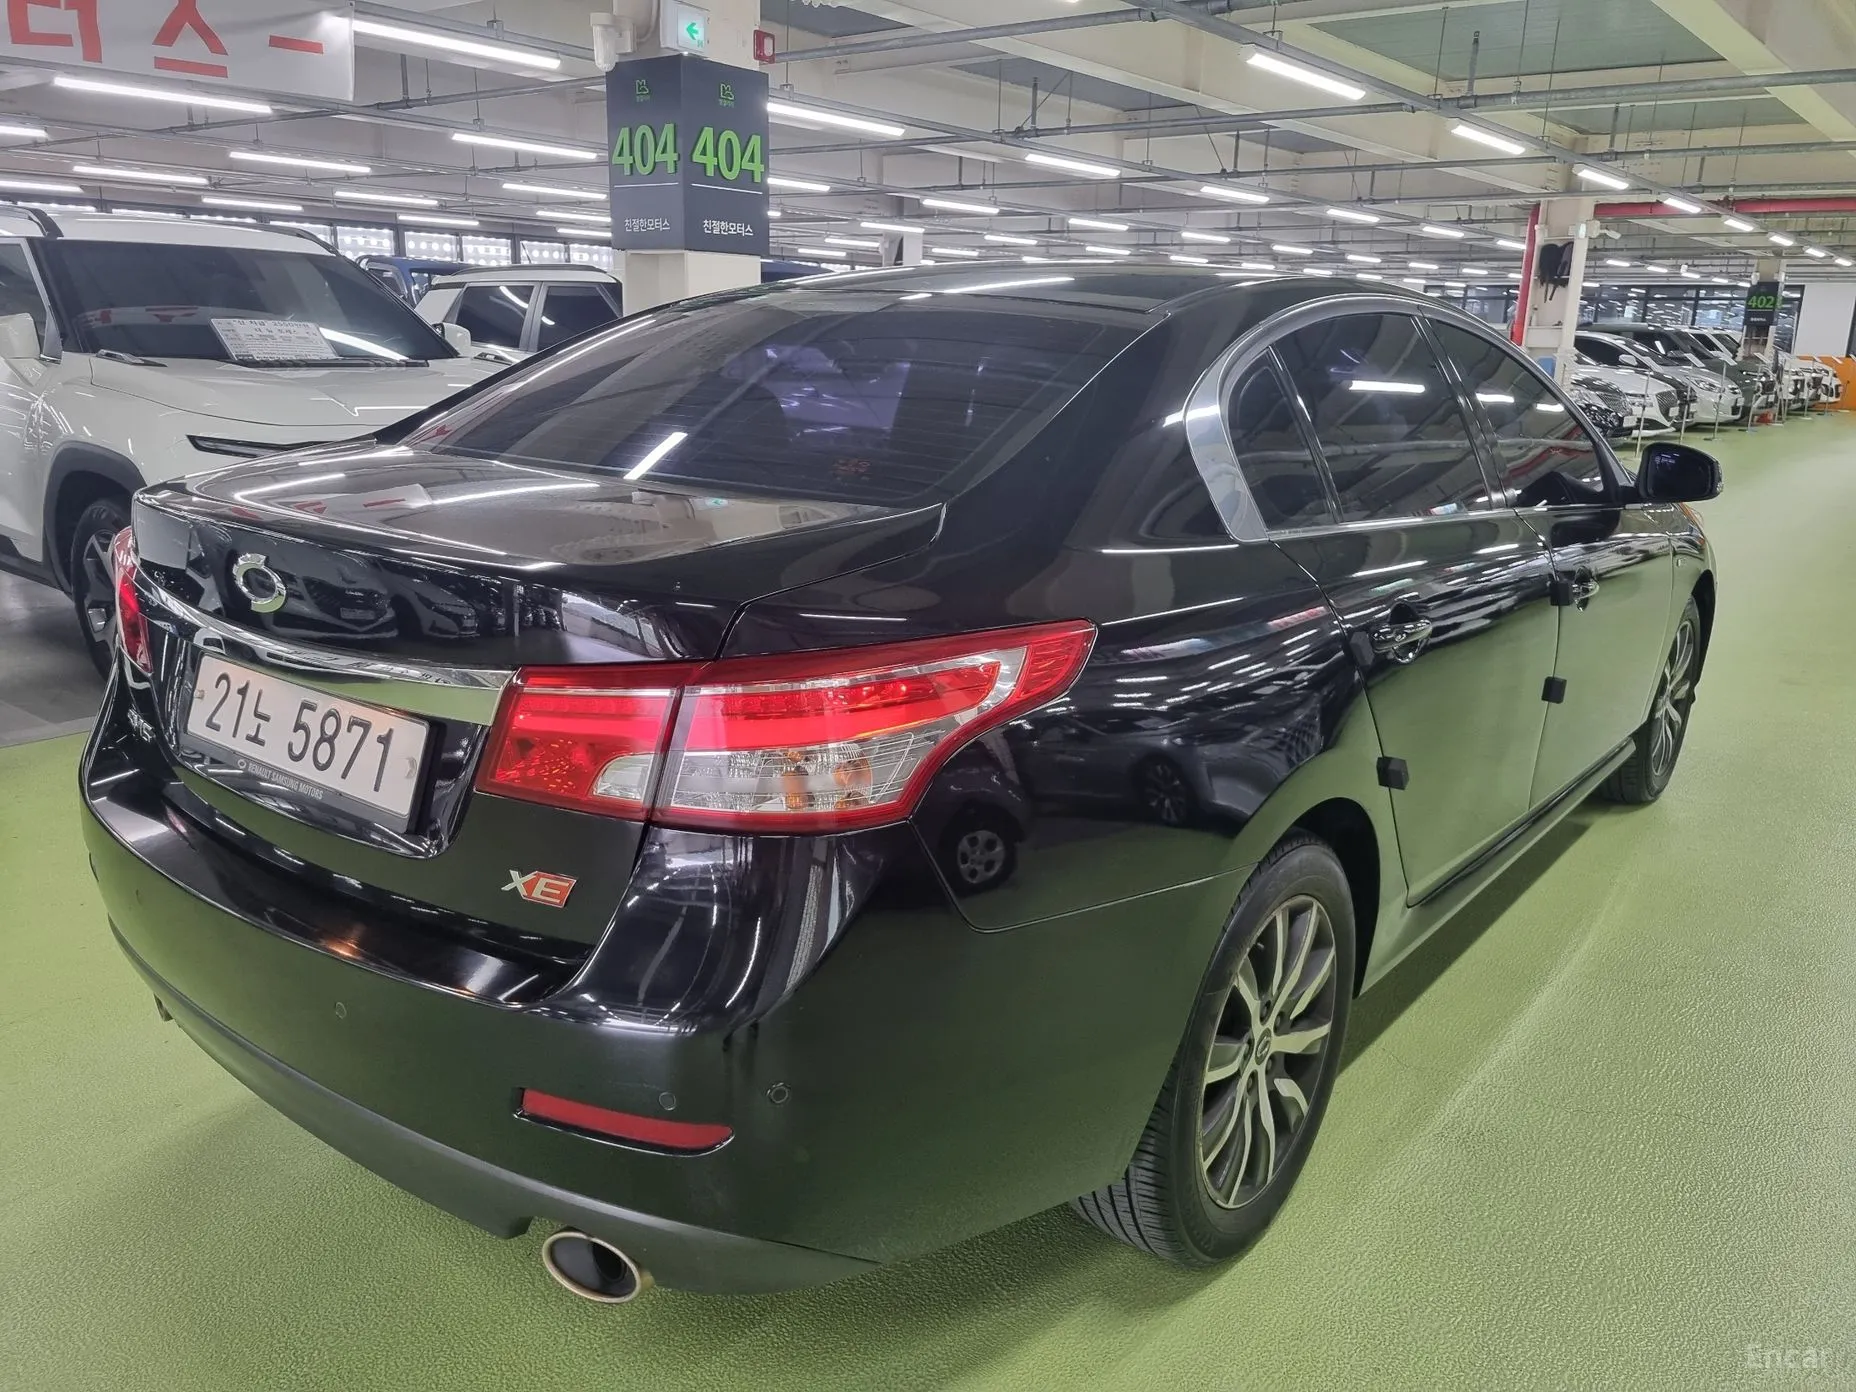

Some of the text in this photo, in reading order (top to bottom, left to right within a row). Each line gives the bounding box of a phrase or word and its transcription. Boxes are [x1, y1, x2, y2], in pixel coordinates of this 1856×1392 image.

[612, 123, 679, 176] 404
[692, 127, 764, 183] 404
[624, 217, 671, 232] 친절한모터스
[703, 219, 754, 237] 친절한모터스
[1747, 295, 1775, 308] 402
[205, 672, 394, 793] 21노 5871
[248, 763, 324, 800] RENAULT SAMSUNG MOTORS
[501, 869, 575, 907] XE
